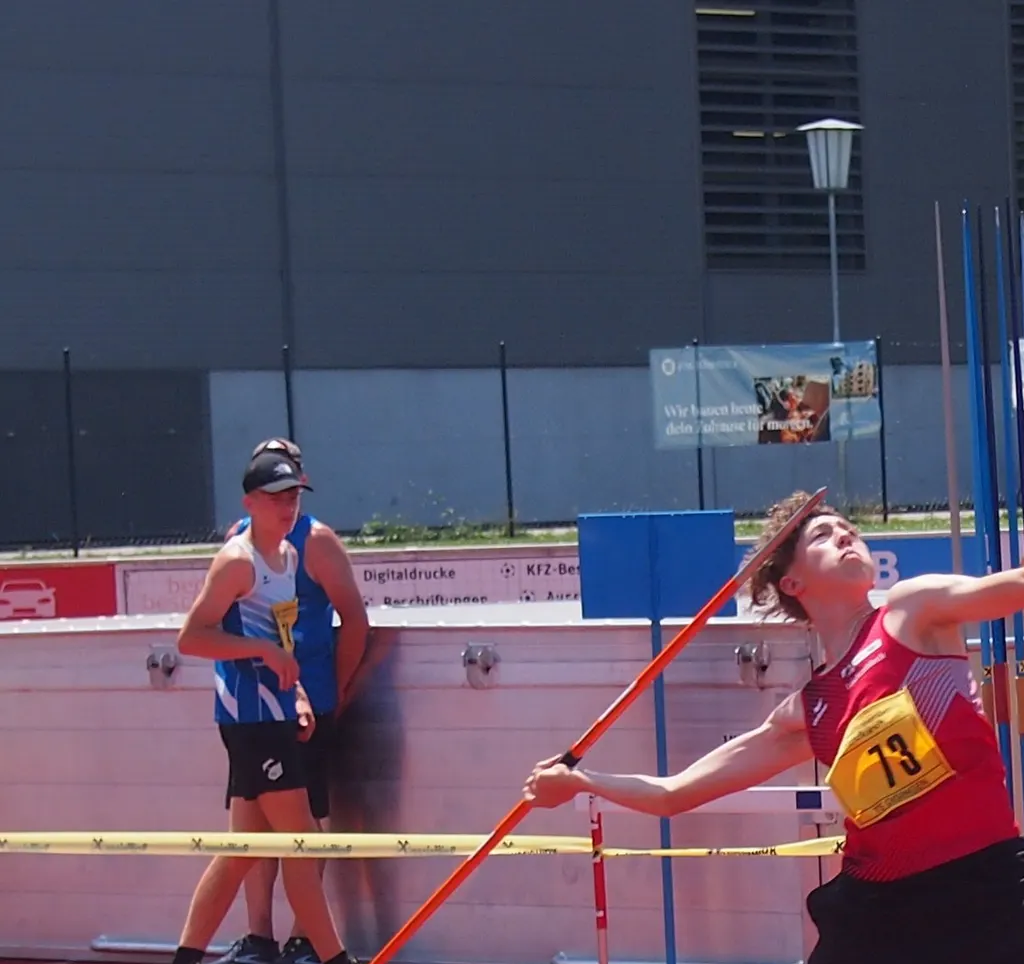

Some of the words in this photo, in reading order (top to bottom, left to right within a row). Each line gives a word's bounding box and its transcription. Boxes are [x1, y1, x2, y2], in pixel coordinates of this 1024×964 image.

[664, 404, 689, 418] Wir
[691, 403, 728, 418] bauen
[665, 421, 693, 436] dein
[363, 563, 456, 584] Digitaldrucke
[867, 733, 923, 788] 73
